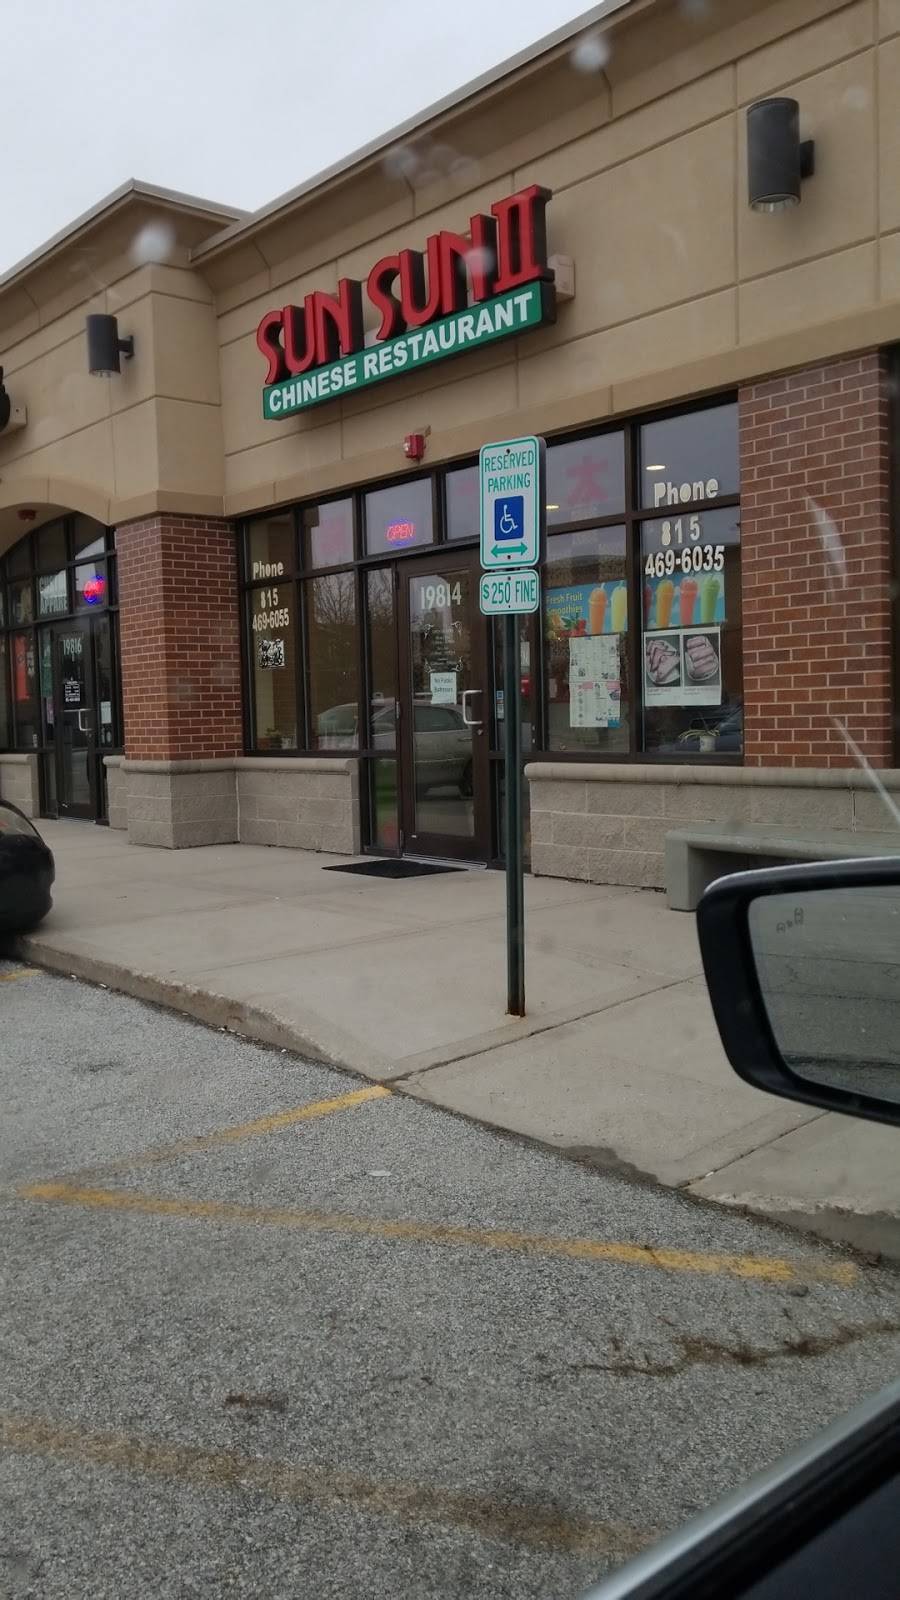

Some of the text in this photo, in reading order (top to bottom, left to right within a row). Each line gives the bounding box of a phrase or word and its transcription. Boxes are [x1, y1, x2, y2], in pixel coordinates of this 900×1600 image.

[257, 278, 358, 385] SUN
[366, 213, 493, 341] SUN
[268, 291, 533, 413] CHINESE RESTAURANT
[484, 450, 535, 473] RESERVED
[487, 472, 531, 493] PARKING
[653, 477, 720, 508] Phone
[386, 522, 415, 542] OPEN
[252, 561, 284, 580] Phone
[644, 544, 725, 579] 469-6035
[260, 588, 279, 609] 815
[420, 580, 463, 610] 19814
[482, 578, 536, 605] $250 FINE
[545, 591, 582, 605] Fresh Fruit
[546, 605, 583, 616] Smoothies
[62, 637, 83, 656] 19816
